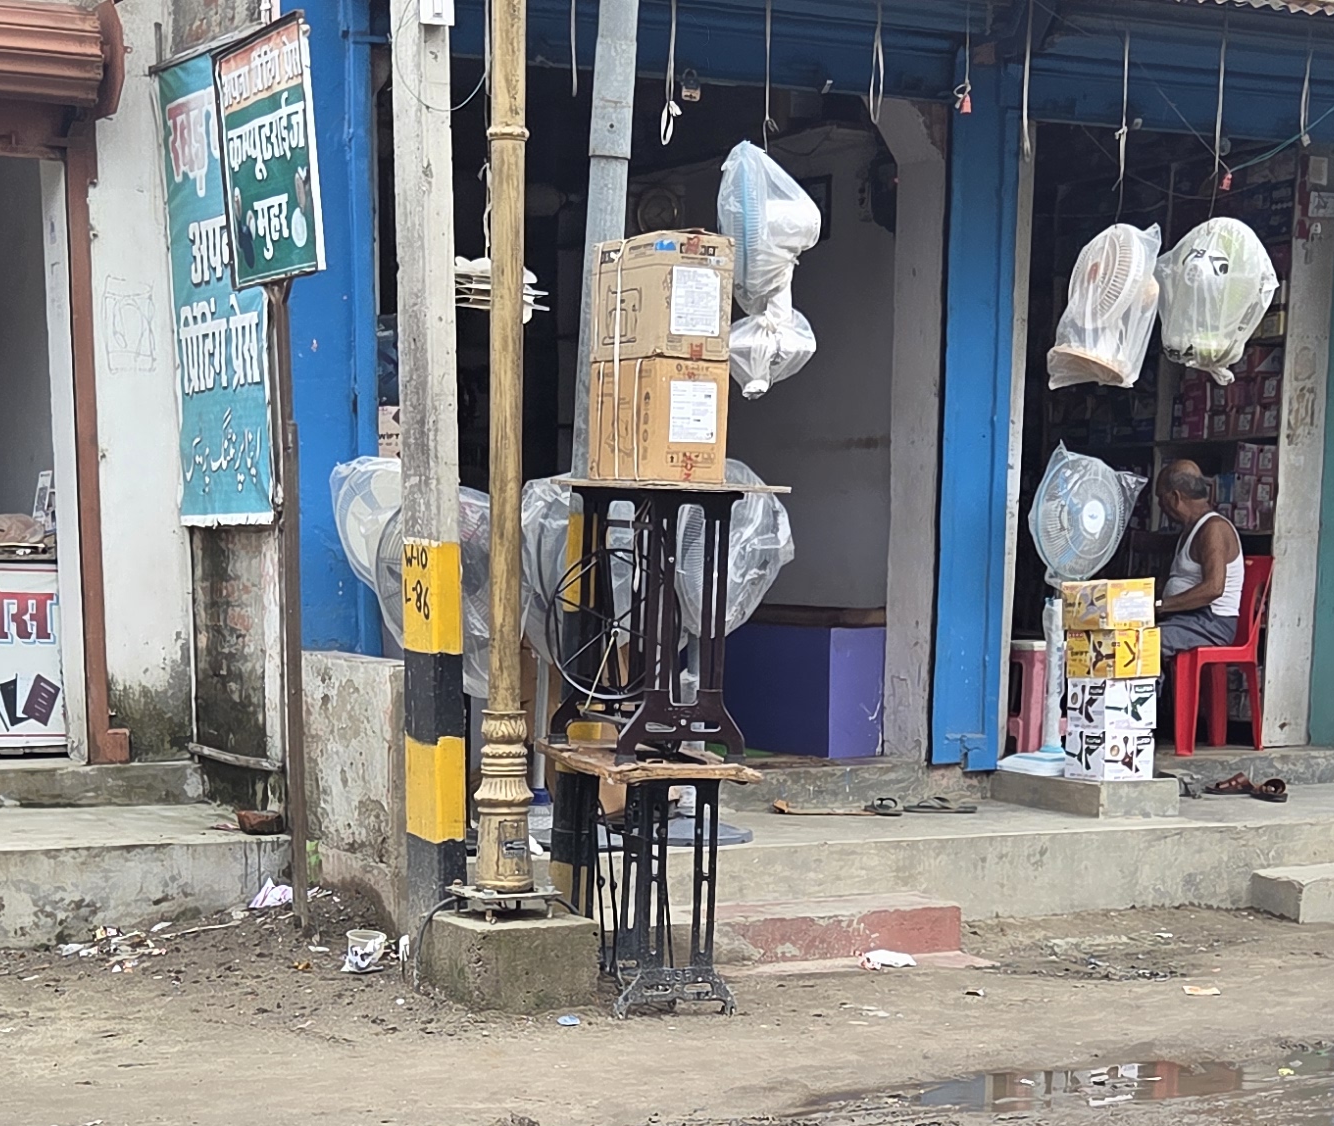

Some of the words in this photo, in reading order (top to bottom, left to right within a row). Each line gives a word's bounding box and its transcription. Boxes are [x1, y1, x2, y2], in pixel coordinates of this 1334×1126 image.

[188, 214, 229, 285] अप
[253, 193, 289, 260] मुहर
[229, 293, 261, 391] प्रेस
